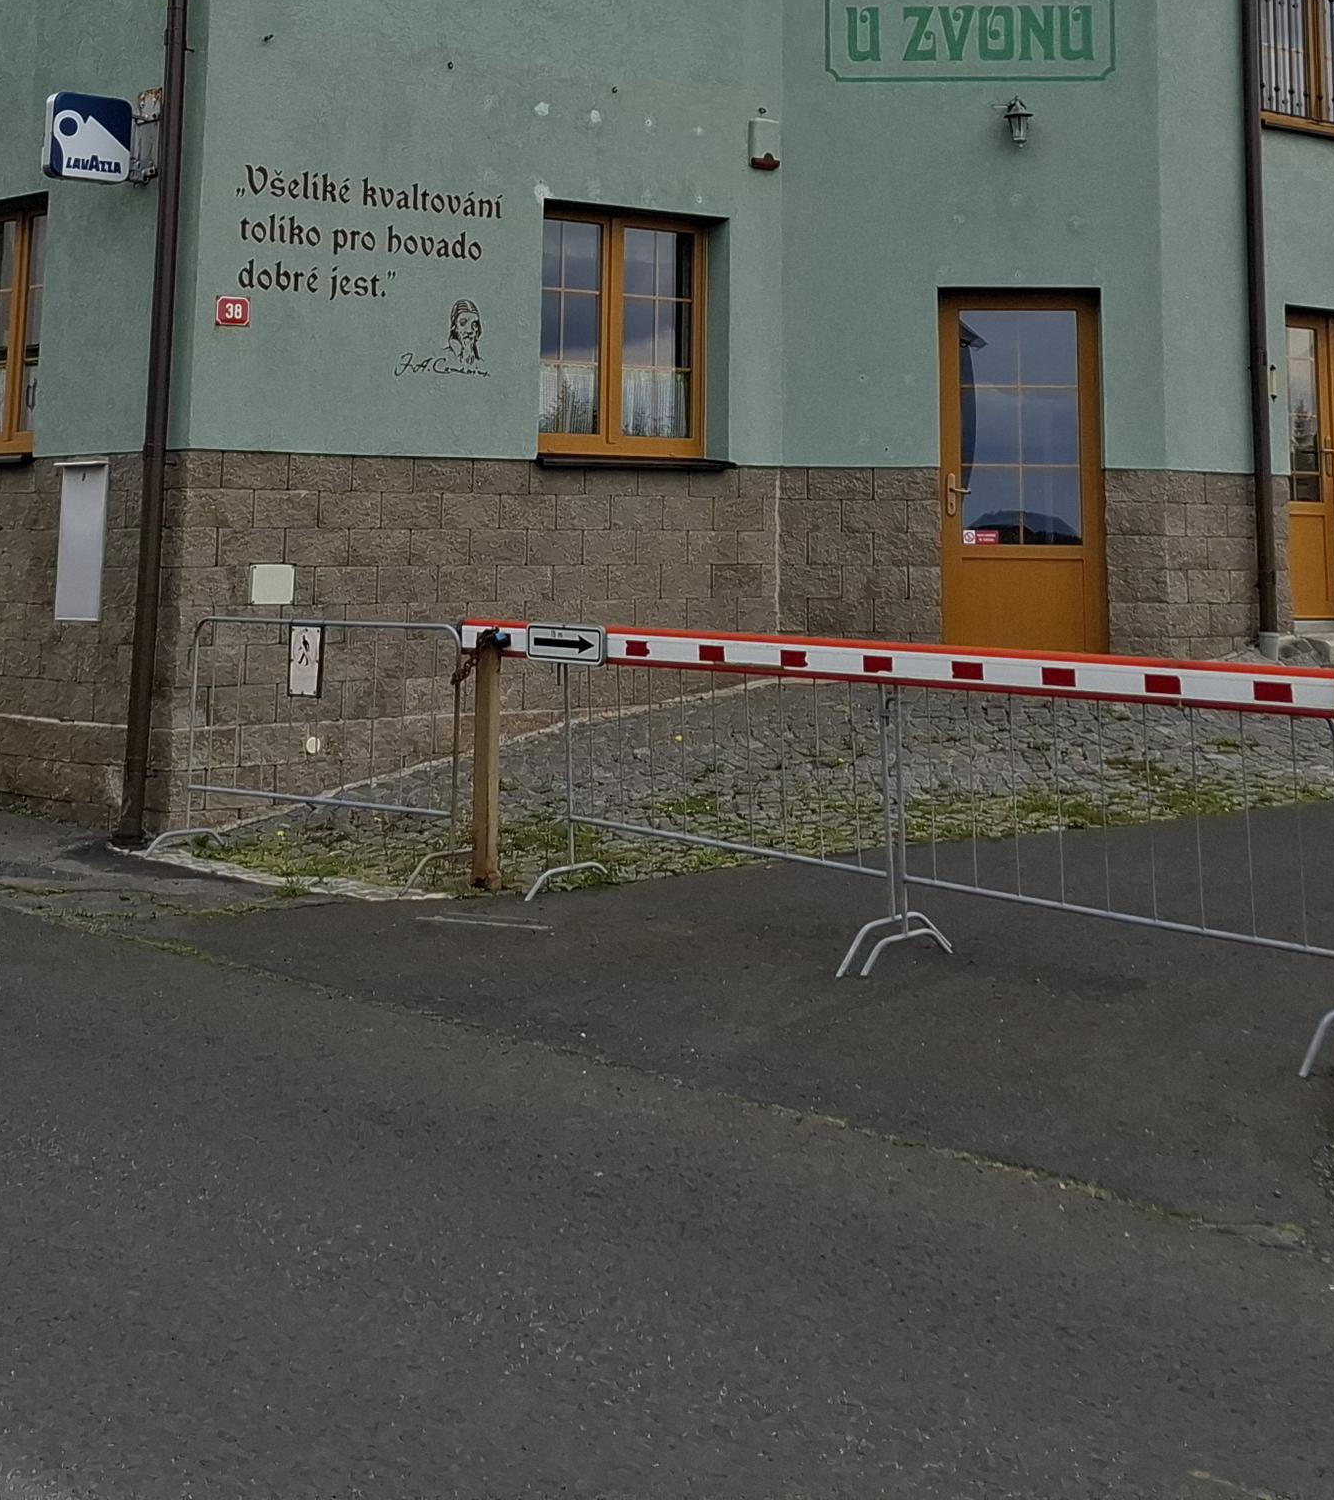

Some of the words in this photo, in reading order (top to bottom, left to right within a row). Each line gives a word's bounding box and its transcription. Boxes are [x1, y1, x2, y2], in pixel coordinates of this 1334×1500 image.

[846, 7, 881, 61] U
[903, 5, 1094, 61] ZVONU
[66, 155, 122, 174] LAVAZZA
[361, 177, 503, 219] kvaltování
[332, 228, 375, 255] pro
[387, 225, 482, 261] hovado
[238, 258, 319, 293] dobré
[225, 303, 242, 319] 38
